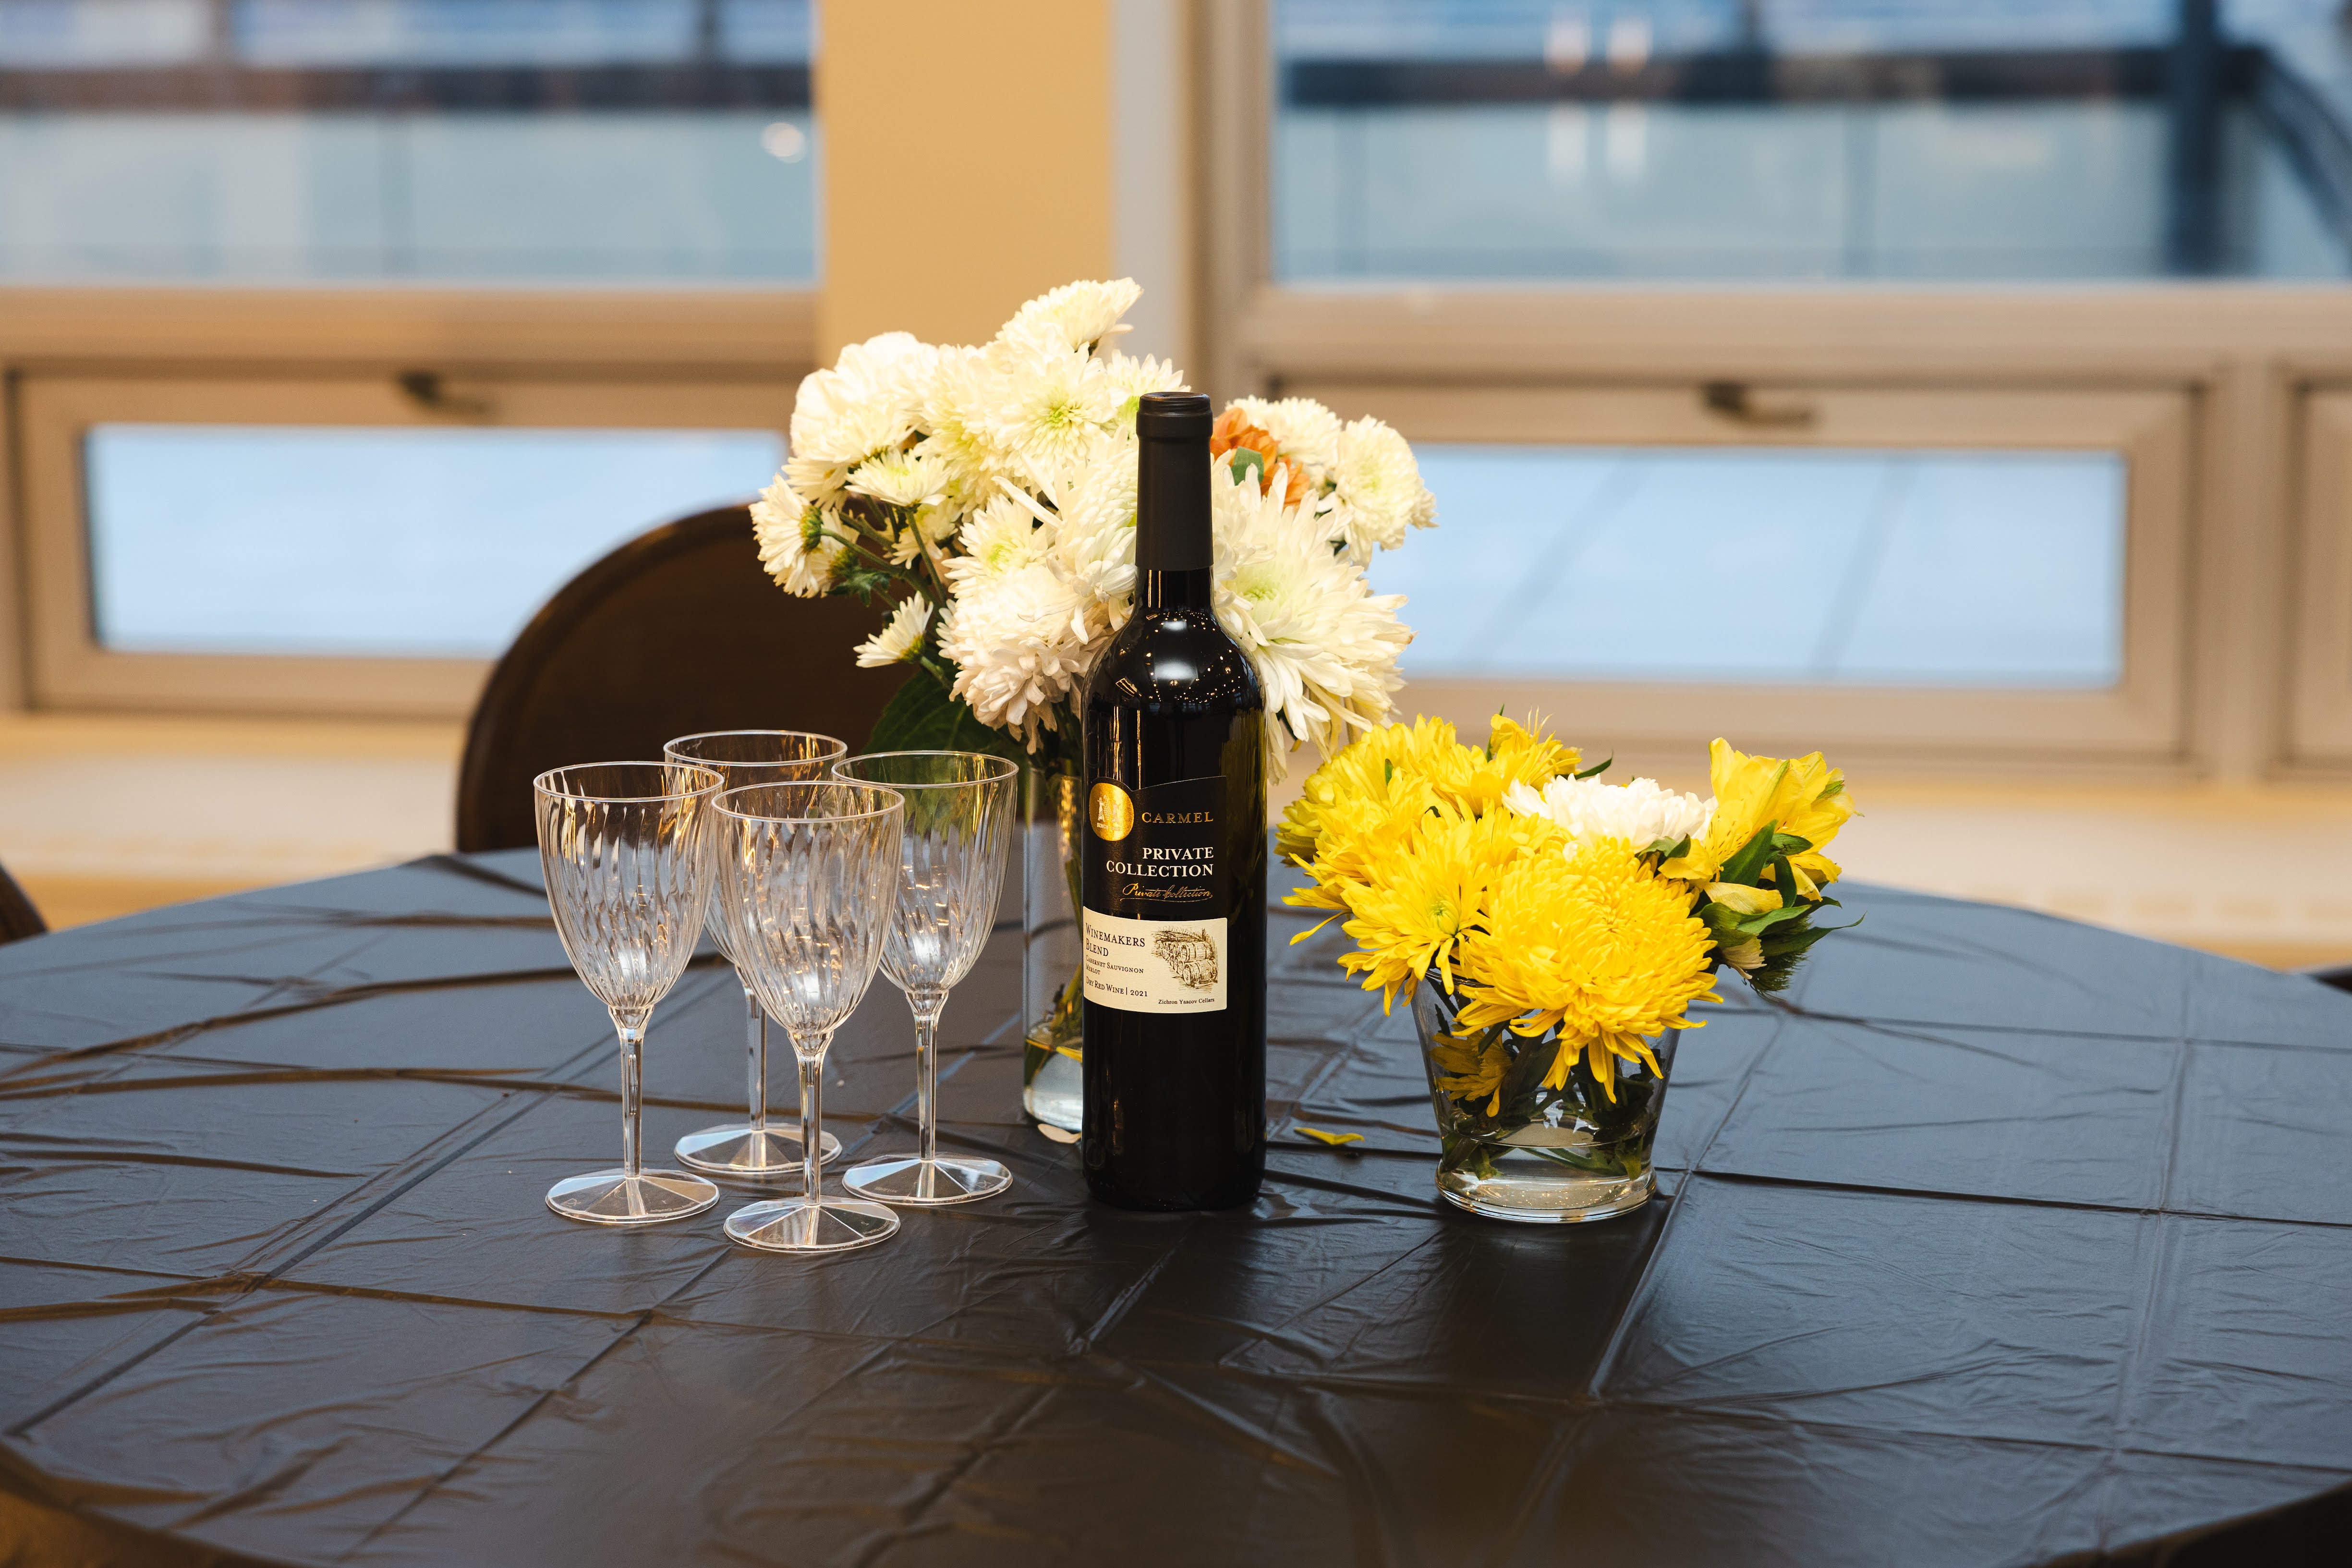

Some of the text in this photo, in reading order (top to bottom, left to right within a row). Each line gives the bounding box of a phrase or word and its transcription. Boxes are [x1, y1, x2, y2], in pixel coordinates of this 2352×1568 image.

[1141, 811, 1213, 824] CARMEL
[1142, 847, 1214, 860] PRIVATE
[1106, 860, 1213, 877] COLLECTION
[1122, 883, 1212, 899] Private Collection
[1085, 923, 1145, 947] WINEMAKERS
[1086, 937, 1109, 956] BLEND
[1086, 963, 1101, 975] MERLOT
[1107, 962, 1144, 973] SAUVIGNON
[1095, 980, 1105, 990] RED
[1106, 984, 1124, 994] WINE
